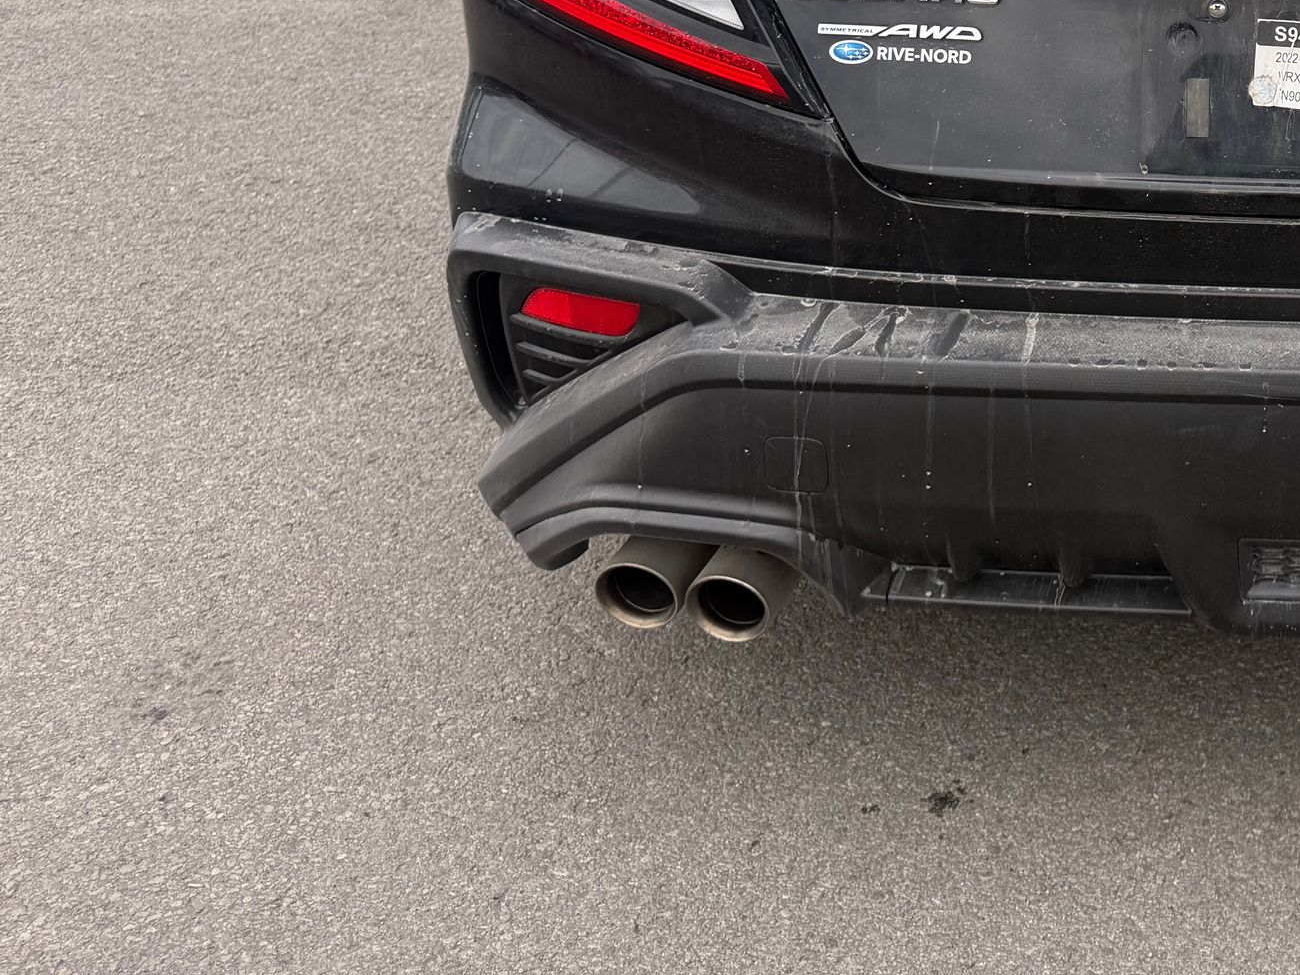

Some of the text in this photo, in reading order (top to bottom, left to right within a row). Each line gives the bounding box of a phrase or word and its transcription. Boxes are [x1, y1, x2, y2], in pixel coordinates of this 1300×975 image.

[820, 24, 982, 41] SYMMETRICAL AWD
[876, 46, 972, 65] RIVE-NORD
